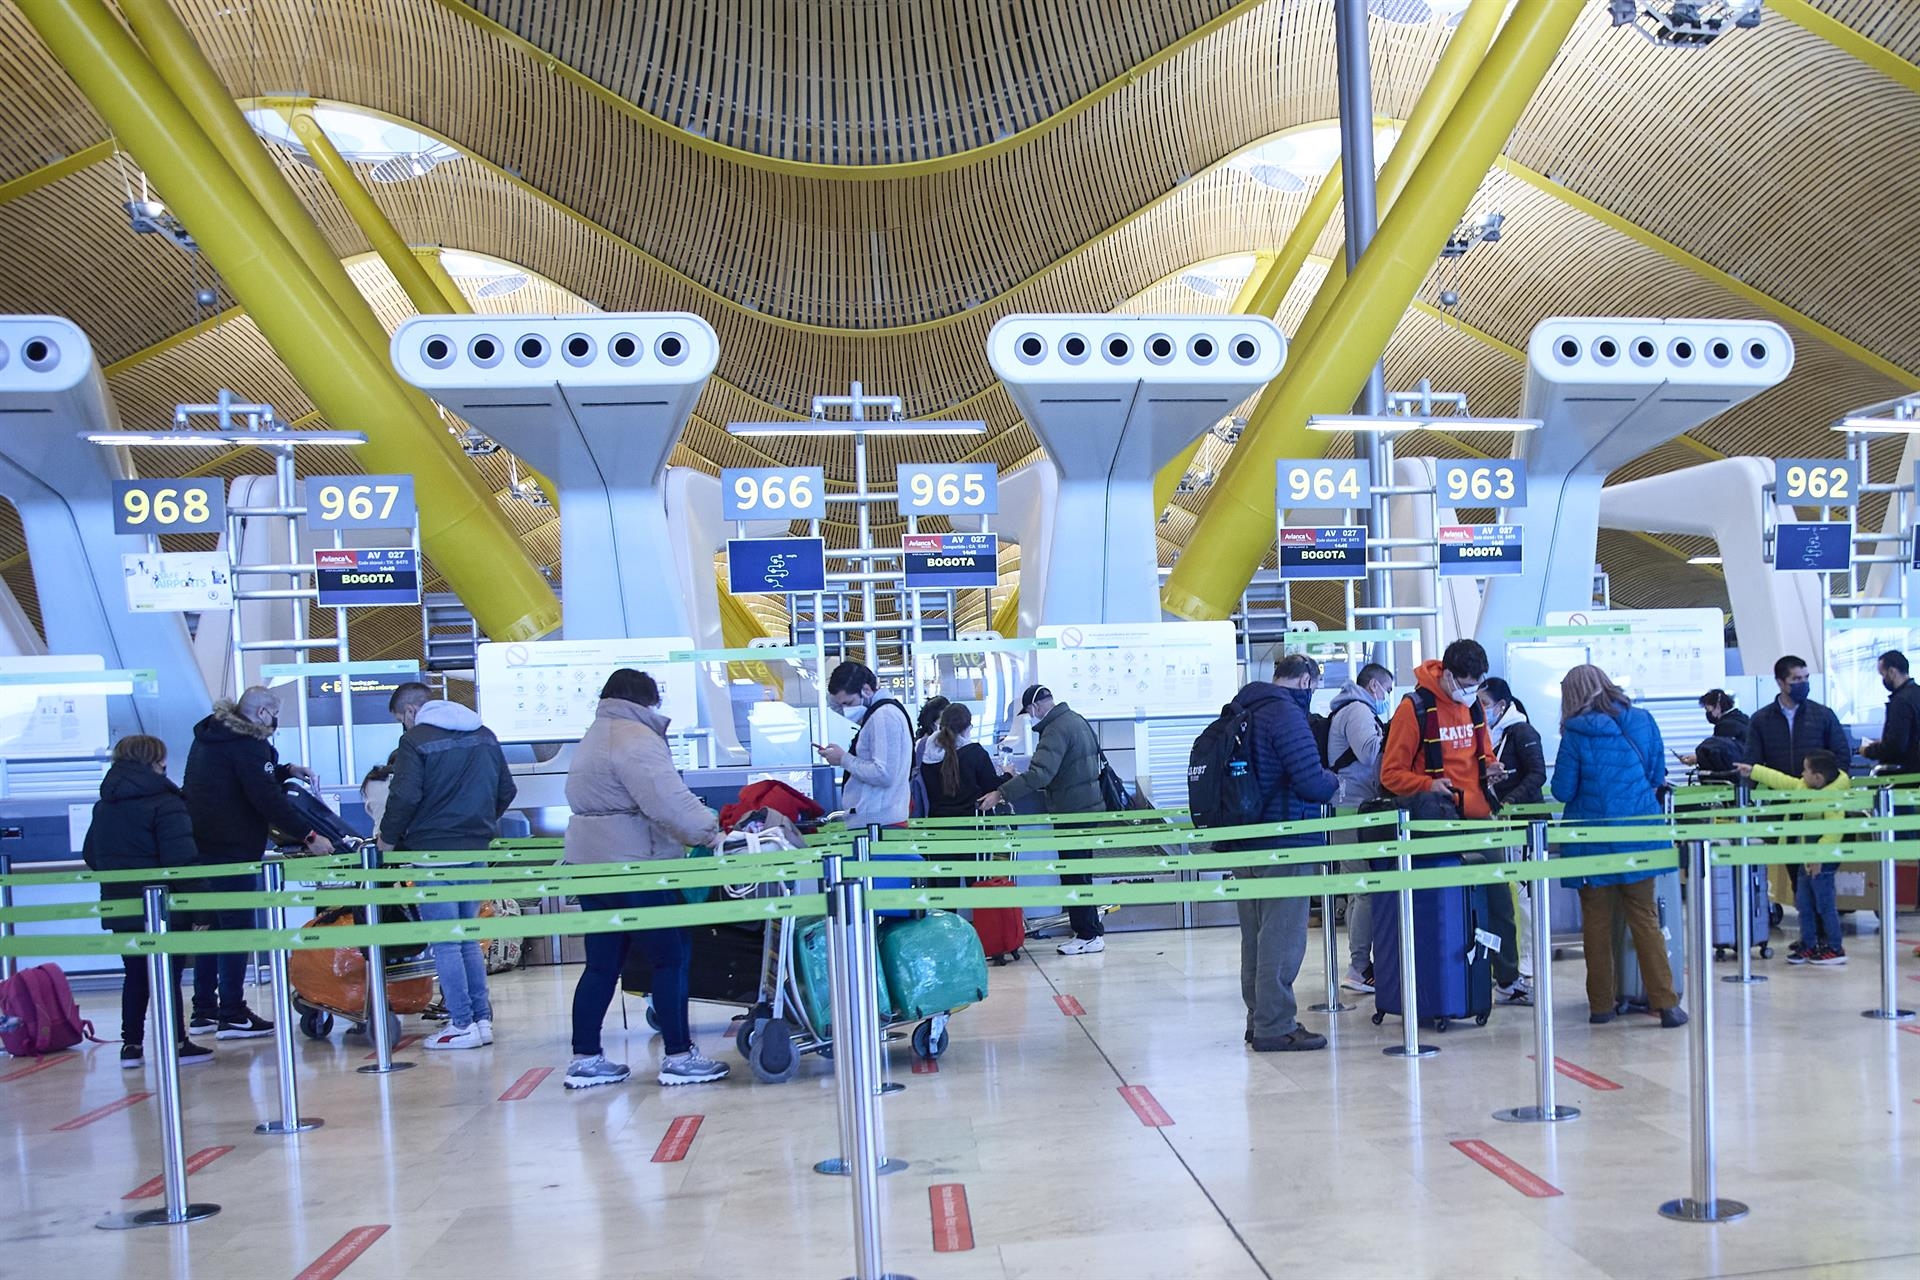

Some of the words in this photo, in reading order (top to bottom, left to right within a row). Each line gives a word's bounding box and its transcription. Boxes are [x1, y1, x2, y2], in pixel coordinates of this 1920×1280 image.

[1288, 468, 1361, 500] 964
[1447, 468, 1515, 500] 963
[1786, 466, 1849, 498] 962
[734, 475, 813, 510] 966
[910, 473, 986, 507] 965
[124, 488, 210, 525] 968
[319, 485, 399, 521] 967
[1342, 529, 1357, 537] 027
[1482, 527, 1494, 535] AV
[970, 535, 986, 543] 027
[367, 551, 381, 560] AV
[387, 551, 405, 559] 027
[1301, 550, 1346, 560] BOGOTA
[1459, 547, 1503, 557] BOGOTA
[321, 555, 347, 563] Avianca
[927, 557, 975, 567] BOGOTA
[341, 573, 394, 585] BOGOTA
